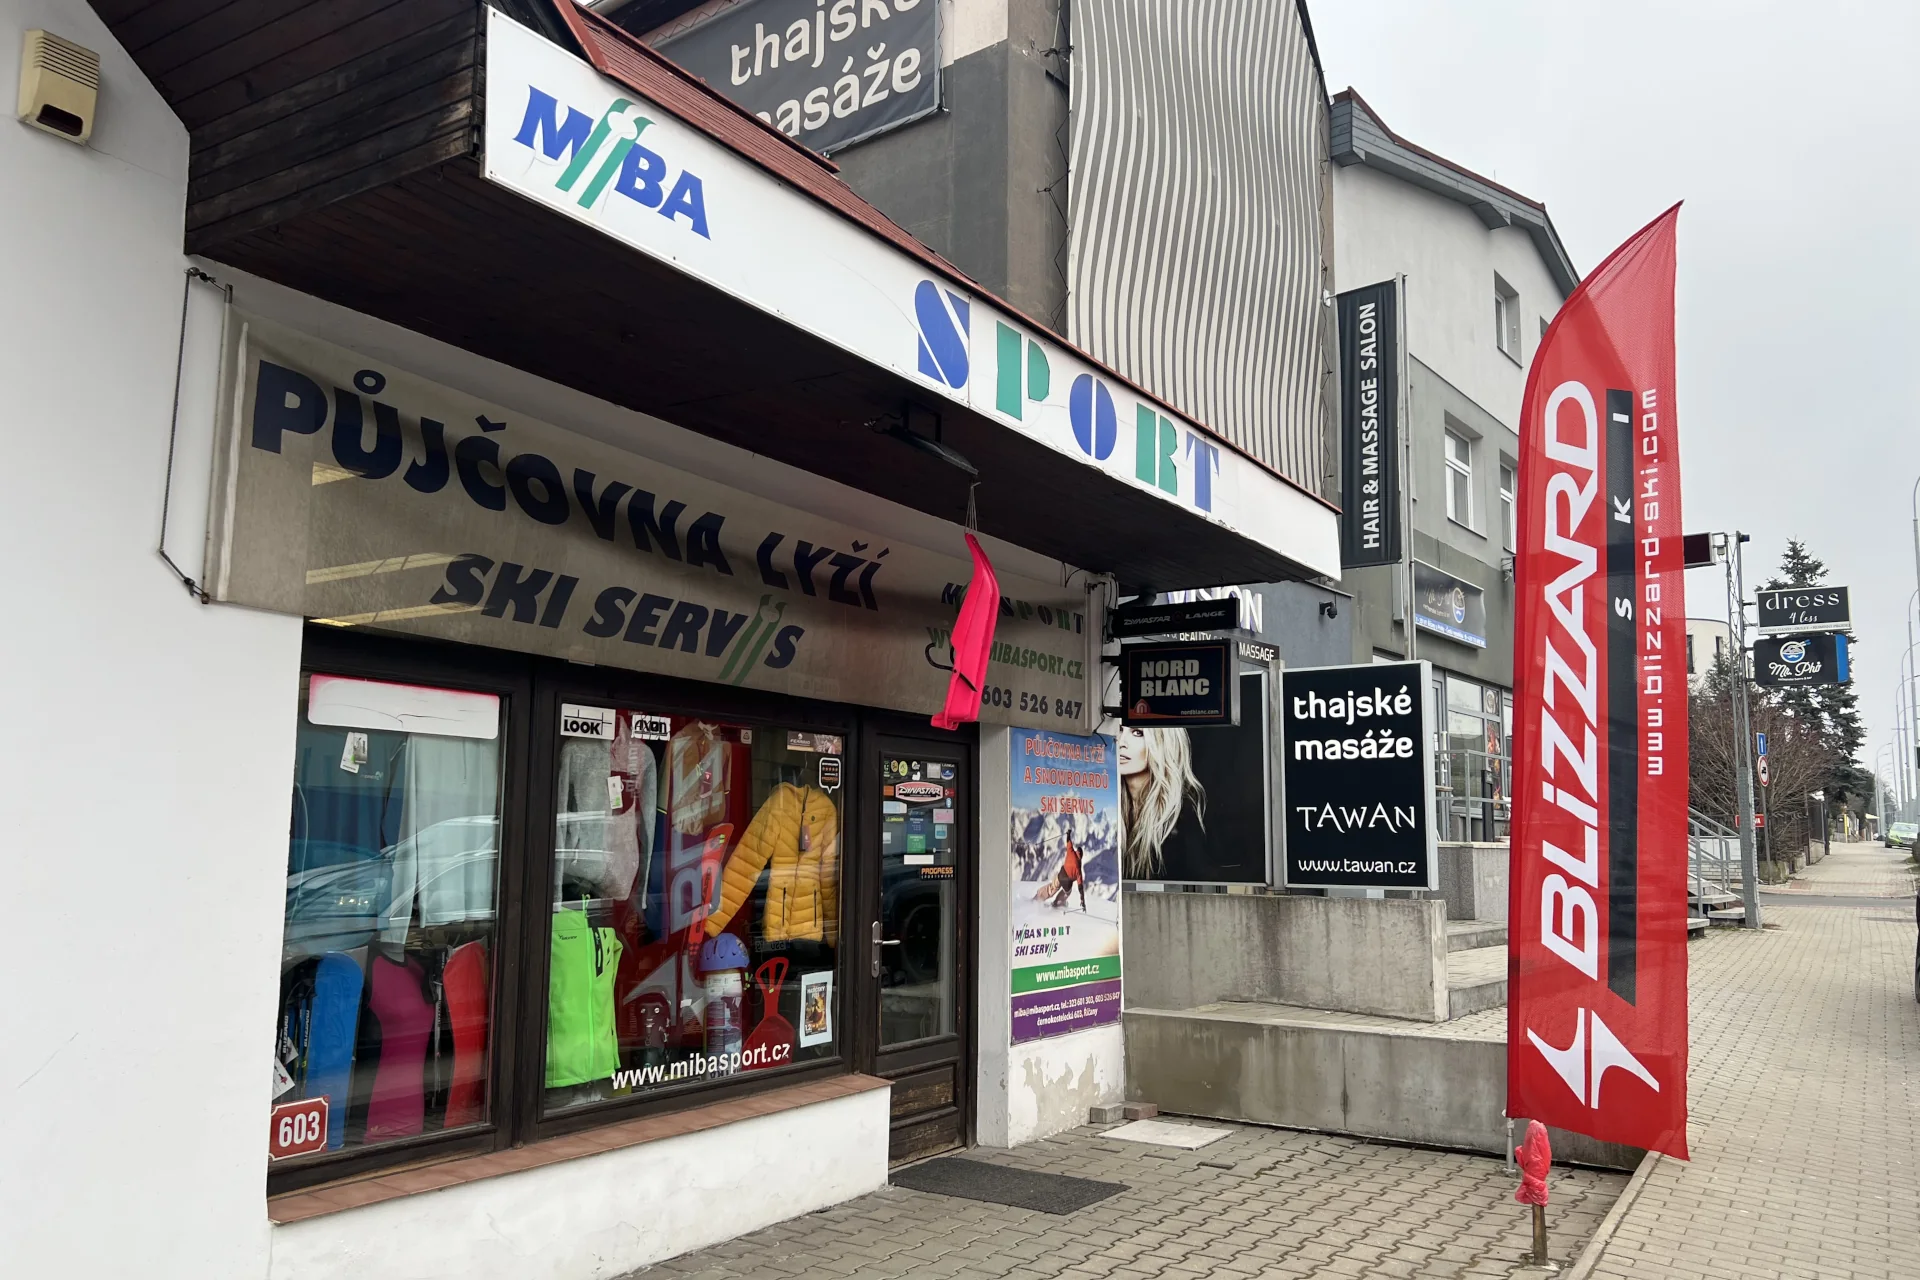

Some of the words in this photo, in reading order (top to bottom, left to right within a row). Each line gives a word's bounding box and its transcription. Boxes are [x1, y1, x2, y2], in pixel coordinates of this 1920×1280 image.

[1359, 302, 1377, 370] SALON
[914, 279, 1219, 513] SPORT
[1361, 377, 1379, 476] MASSAGE
[252, 360, 734, 576] PŮJČOVNA
[756, 531, 890, 612] LYŽÍ
[1362, 479, 1379, 496] &
[1363, 498, 1380, 549] HAIR
[1639, 388, 1664, 776] www.blizzard-ski.com
[1765, 593, 1840, 610] dress
[429, 553, 580, 629] SKI
[582, 586, 805, 687] SERVIS
[1124, 615, 1171, 626] DYNASTAR
[1185, 610, 1226, 619] LANGE
[1789, 611, 1796, 623] 4
[1799, 611, 1818, 623] less
[1140, 659, 1200, 678] NORD
[1768, 662, 1792, 677] Mr.
[1140, 678, 1209, 697] BLANC
[982, 685, 1012, 709] 603
[1019, 691, 1048, 714] 526
[1055, 698, 1082, 720] 847
[1180, 708, 1219, 716] nordblanc.com
[1294, 684, 1412, 725] thajské
[564, 719, 601, 735] LOOK
[1025, 734, 1082, 760] PŮJČOVNA
[1084, 743, 1105, 763] LYŽÍ
[1295, 728, 1413, 761] masáže
[1024, 766, 1032, 783] A
[1034, 767, 1109, 790] SNOWBOARDŮ
[898, 786, 941, 795] DYNASTAR
[1040, 796, 1057, 813] SKI
[1060, 796, 1095, 815] SERVIS
[1296, 802, 1416, 833] TAWAN
[921, 867, 954, 875] PROGRESS
[1298, 858, 1416, 873] www.tawan.cz
[1036, 926, 1071, 938] SPORT
[1015, 945, 1028, 957] SKI
[1030, 937, 1058, 958] SERVIS
[1036, 964, 1099, 982] www.mibasport.cz
[611, 1042, 791, 1090] www.mibasport.cz
[279, 1111, 320, 1148] 603
